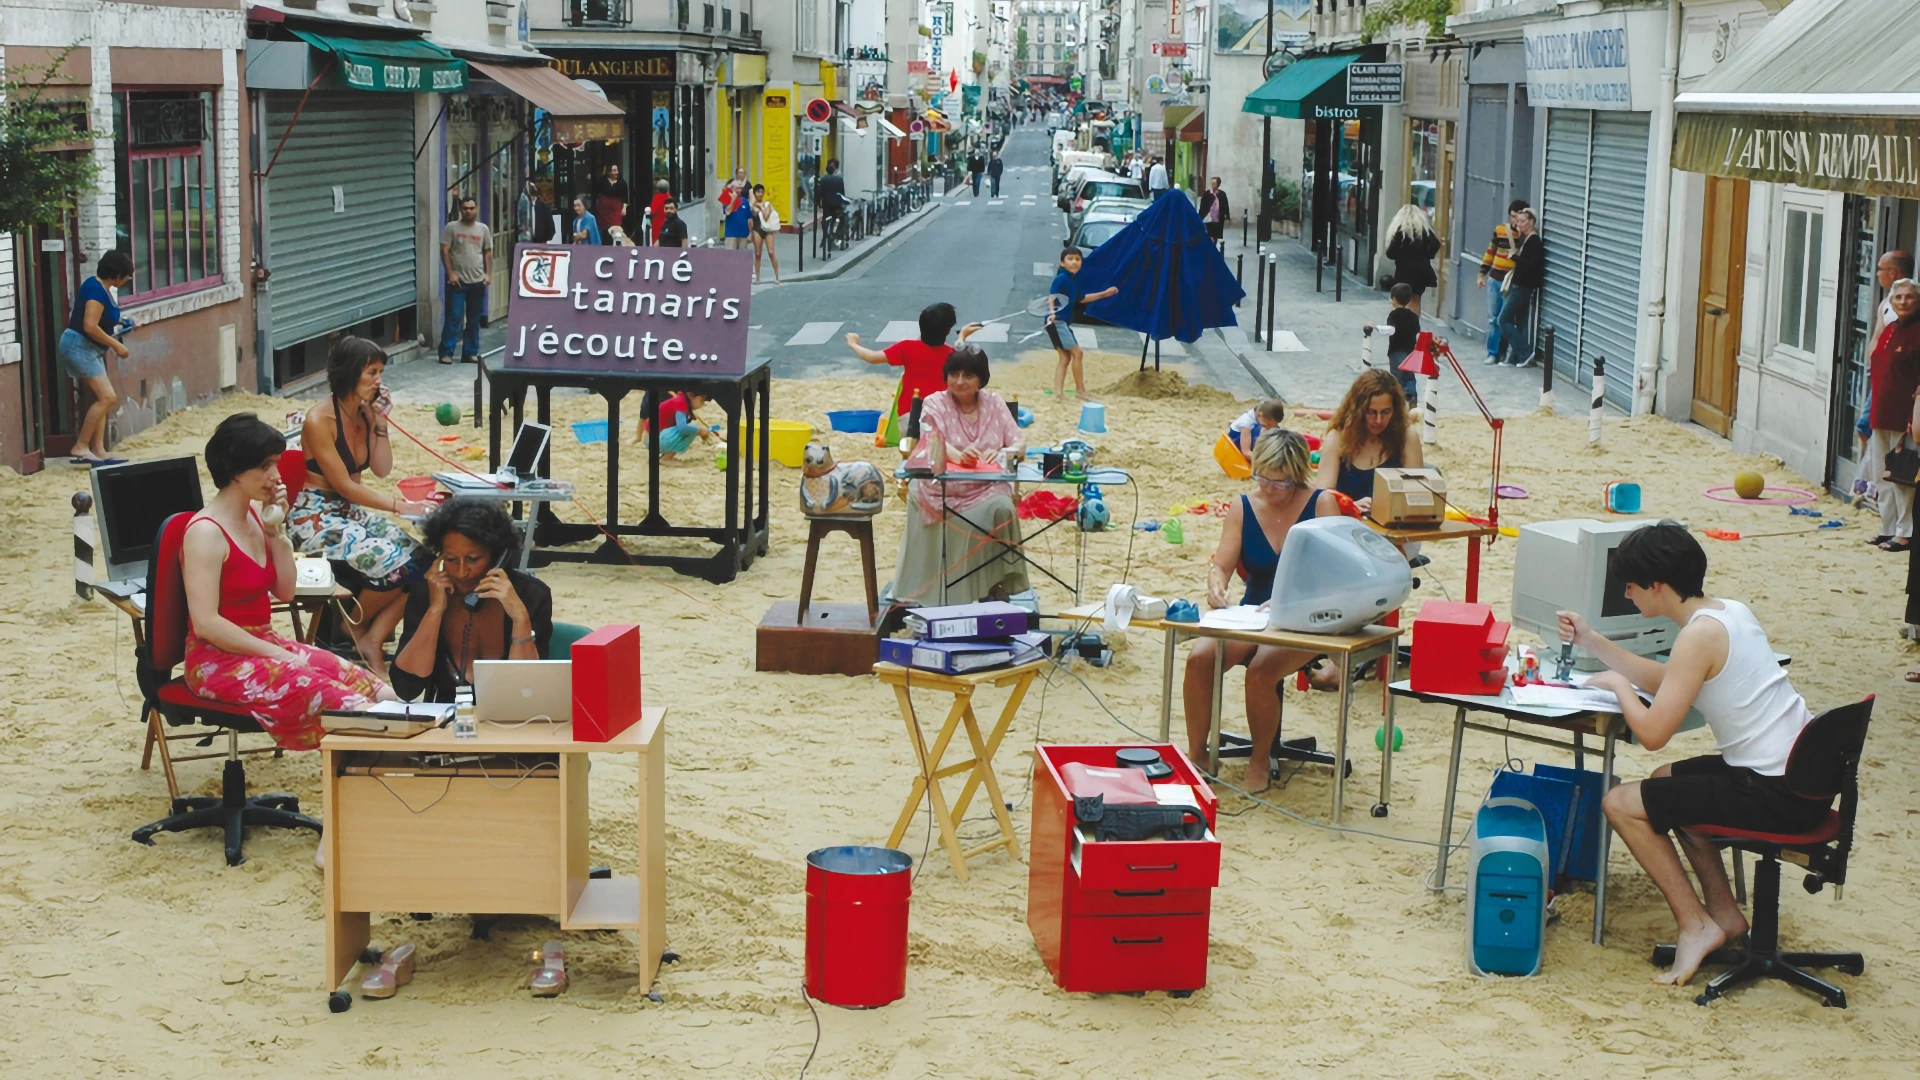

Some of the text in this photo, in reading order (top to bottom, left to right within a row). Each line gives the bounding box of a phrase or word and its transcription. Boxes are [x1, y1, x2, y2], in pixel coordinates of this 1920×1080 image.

[547, 58, 672, 76] OULANGERIE
[1315, 105, 1359, 118] bistrot
[1814, 132, 1920, 185] REMPAILL
[594, 248, 694, 283] ciné
[571, 282, 741, 321] tamaris
